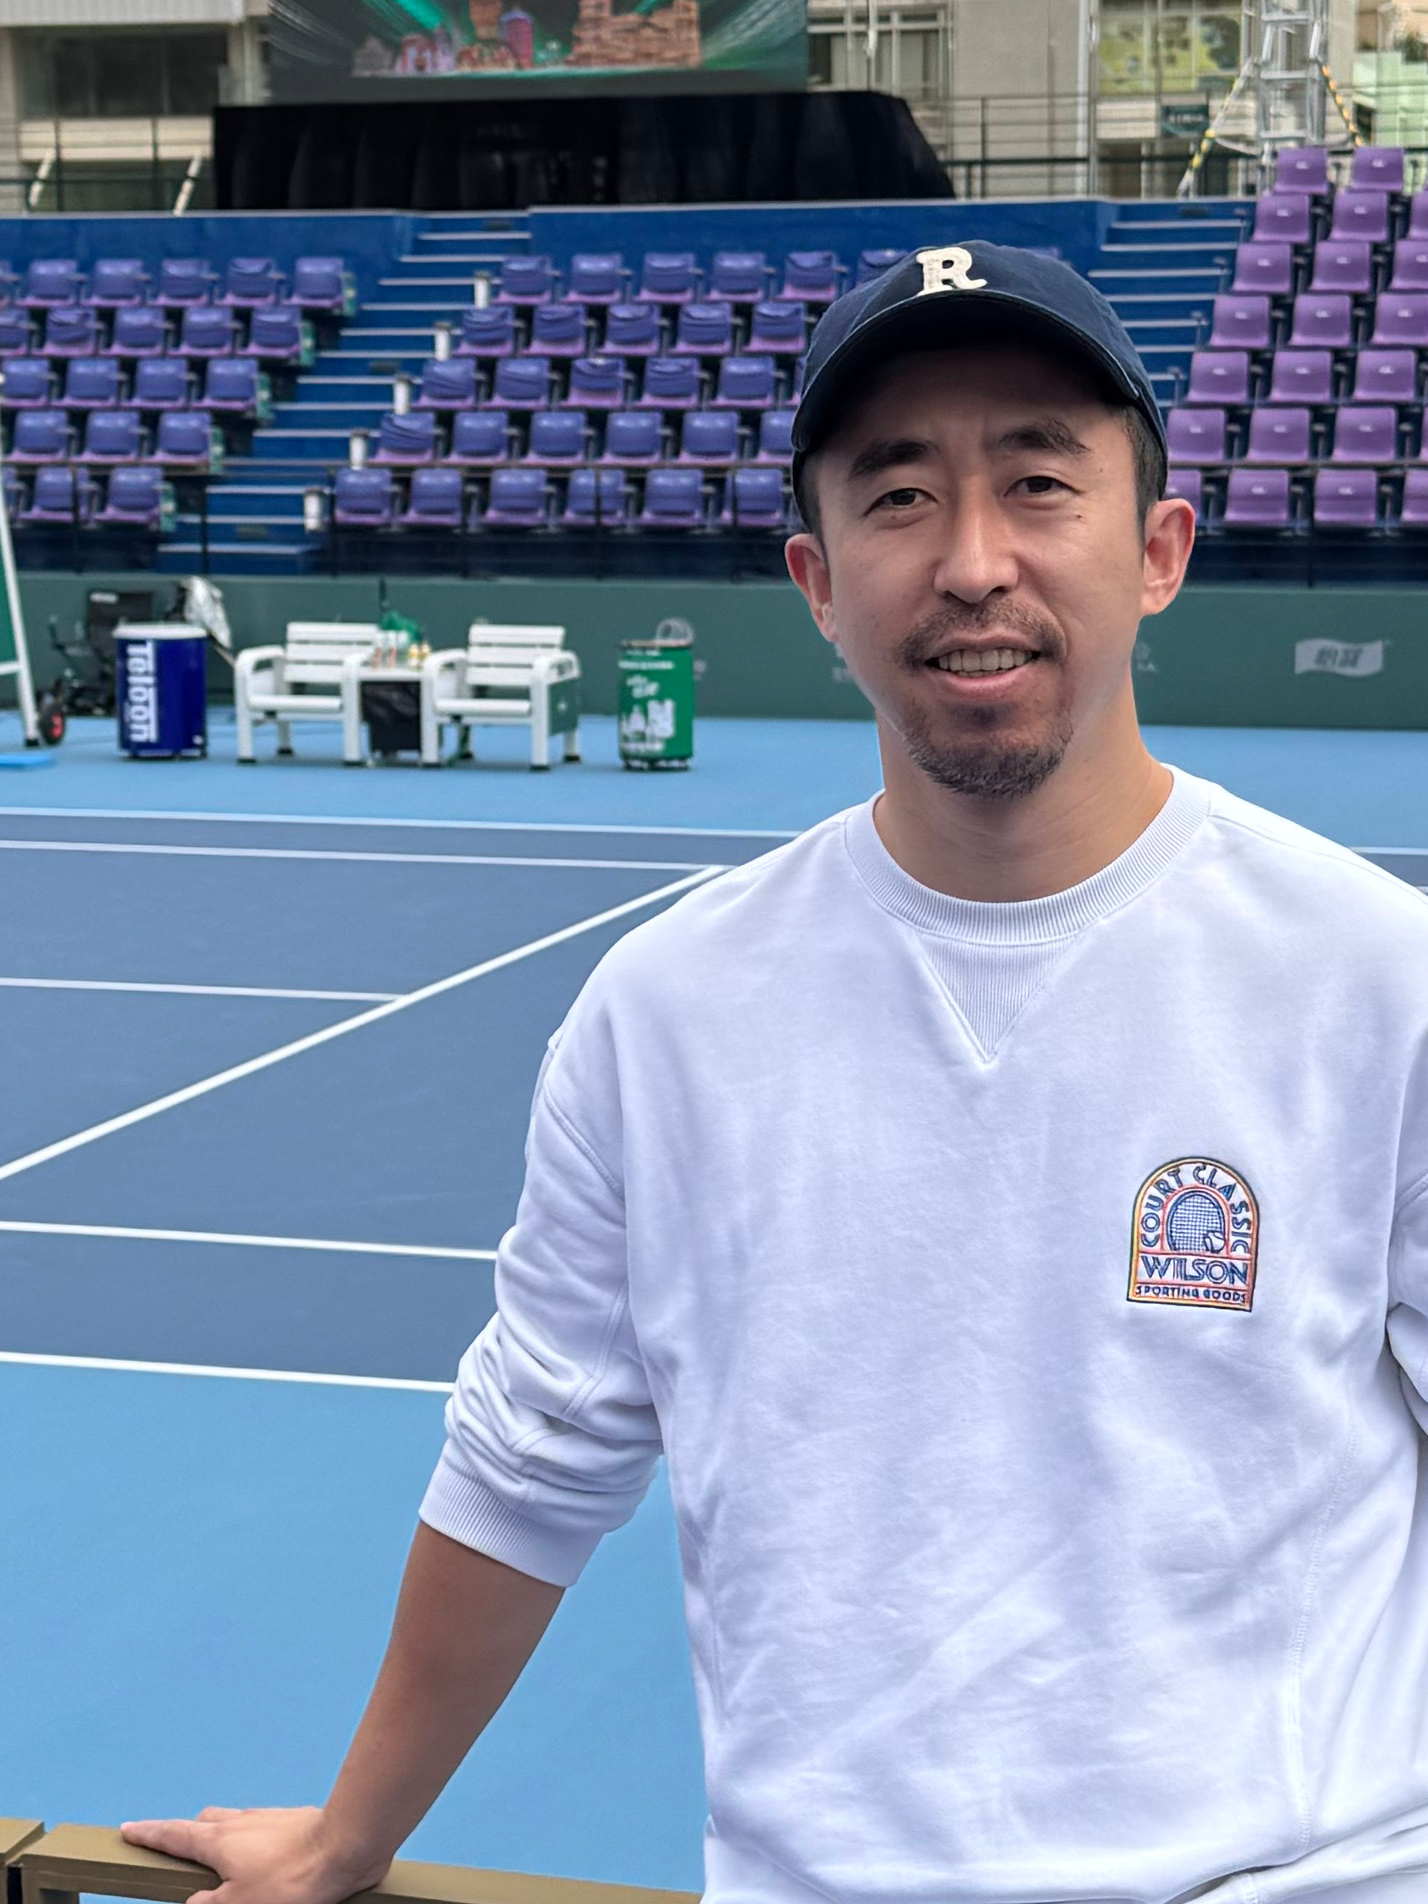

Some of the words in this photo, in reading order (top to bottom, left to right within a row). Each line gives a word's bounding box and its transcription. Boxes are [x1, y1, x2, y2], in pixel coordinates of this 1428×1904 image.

[916, 247, 987, 296] R
[126, 641, 157, 743] Teloon
[1141, 1168, 1184, 1248] COURT
[1193, 1164, 1251, 1254] CLASSIC
[1136, 1285, 1199, 1298] SPORTING
[1203, 1287, 1246, 1303] GOODS
[1141, 1255, 1249, 1285] WILSON
